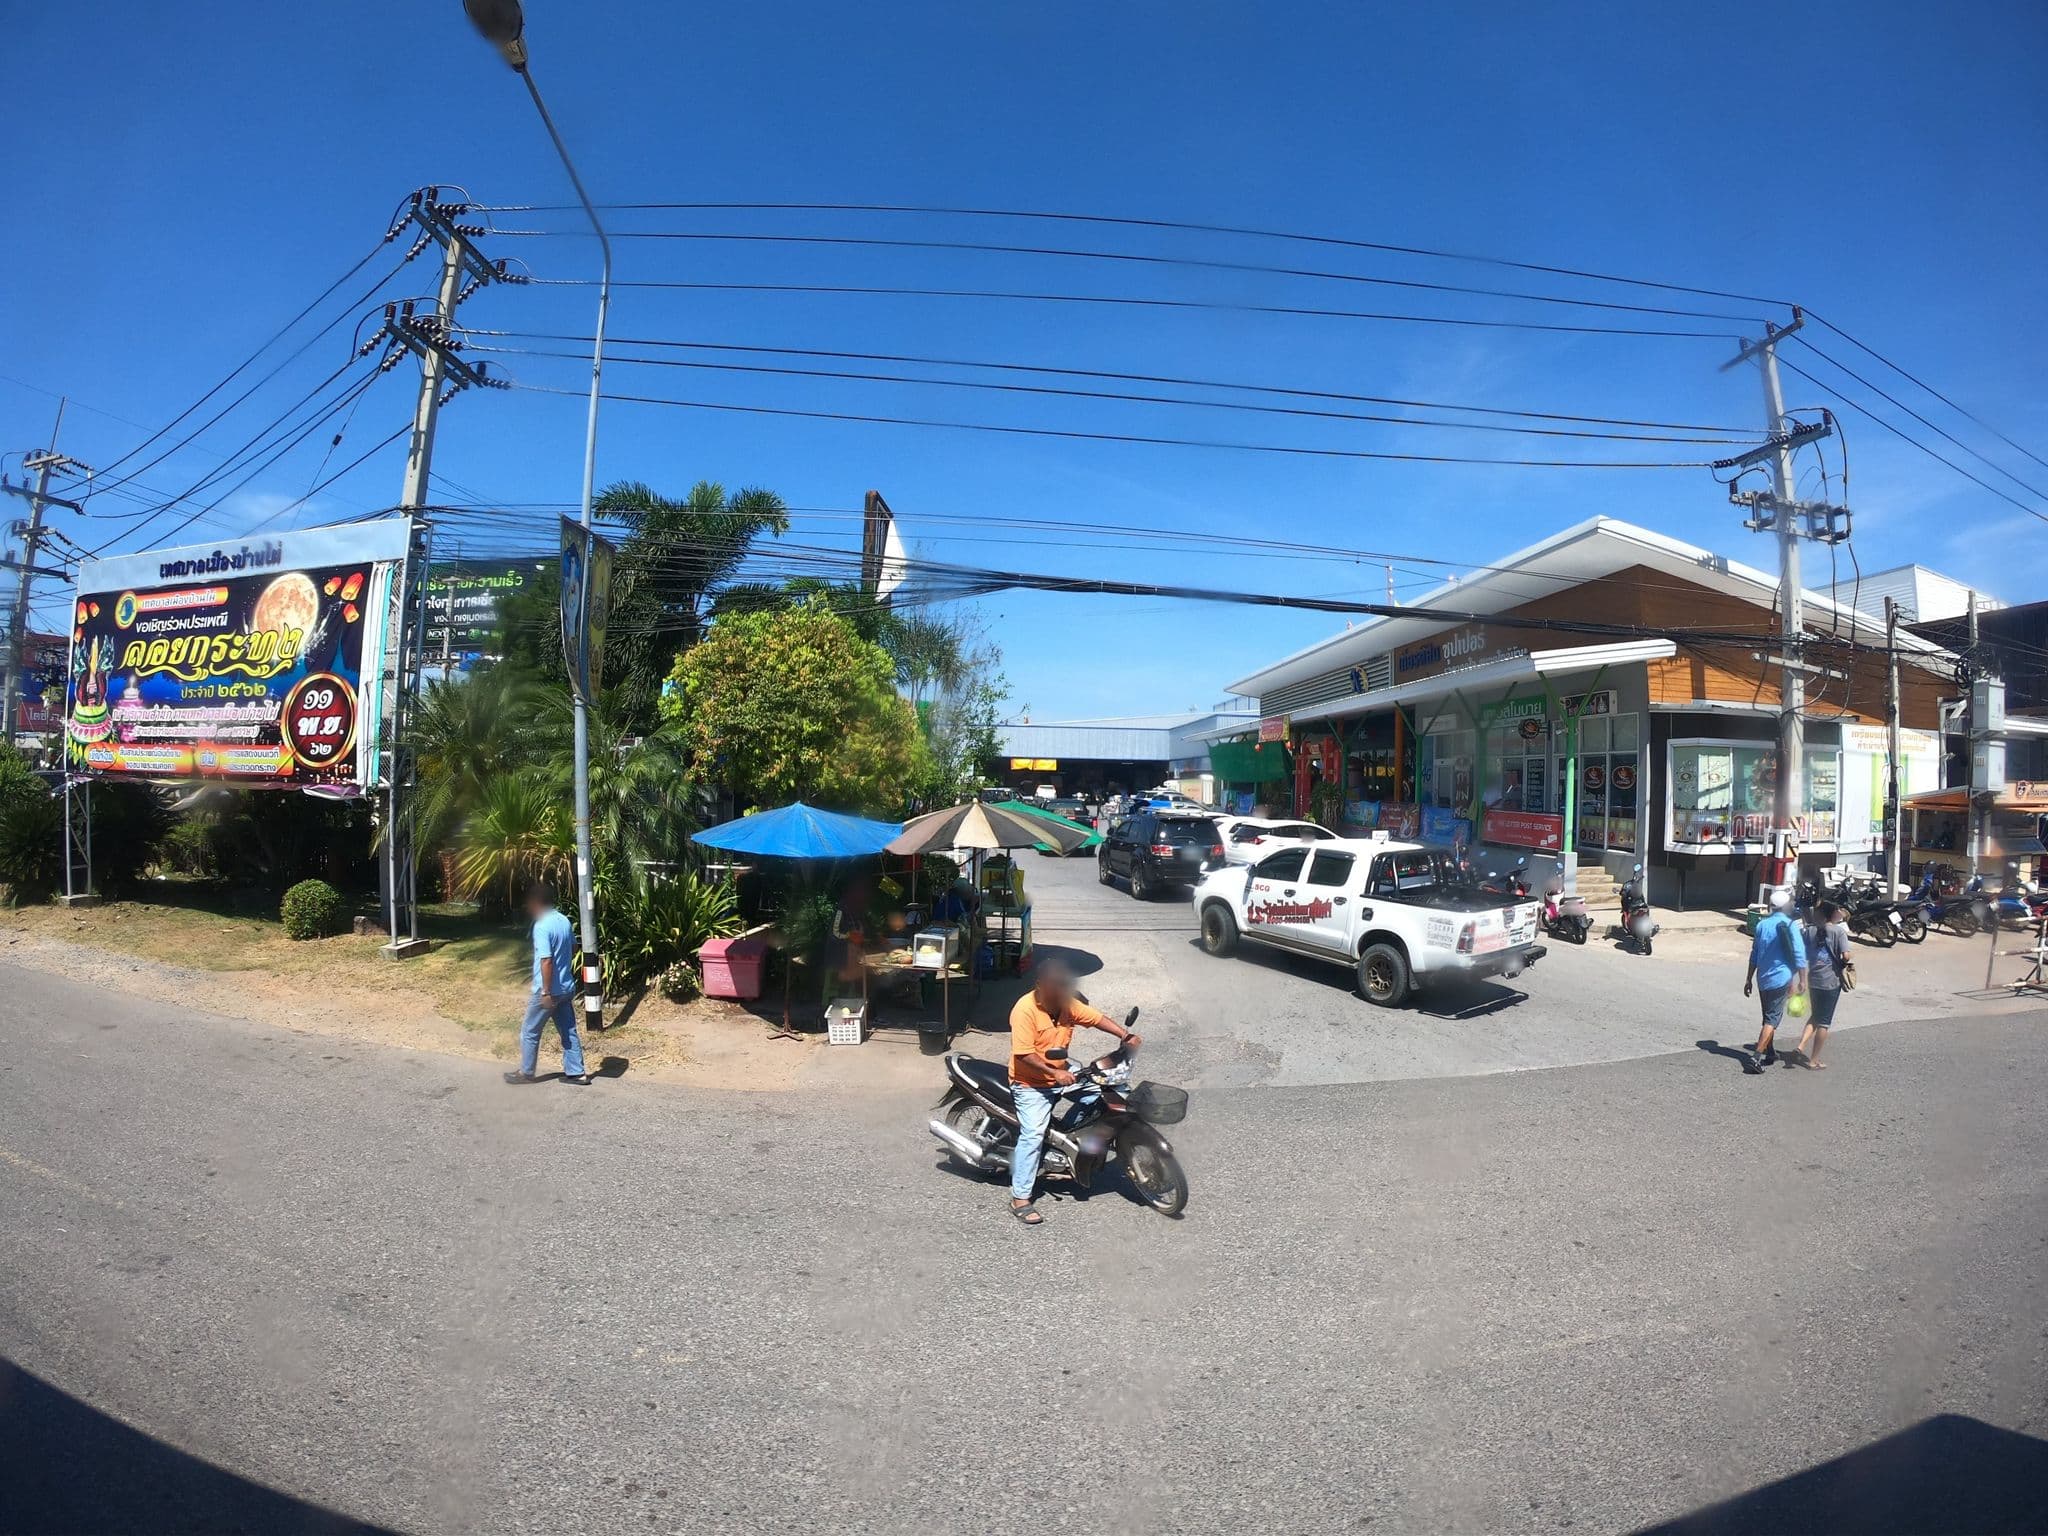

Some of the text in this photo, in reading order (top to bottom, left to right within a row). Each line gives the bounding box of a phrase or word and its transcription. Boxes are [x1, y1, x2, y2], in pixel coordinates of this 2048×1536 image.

[159, 541, 283, 578] เทศบาลเมืองบ้านไผ่
[136, 612, 228, 633] ขอเชิญร่วมประเพณี
[118, 622, 304, 681] ลอยกระทง
[181, 682, 267, 699] ประจำปี ๒๕๖๒
[303, 689, 334, 710] ๑๑
[298, 716, 345, 736] พ.ย.
[310, 742, 332, 755] ๖๒
